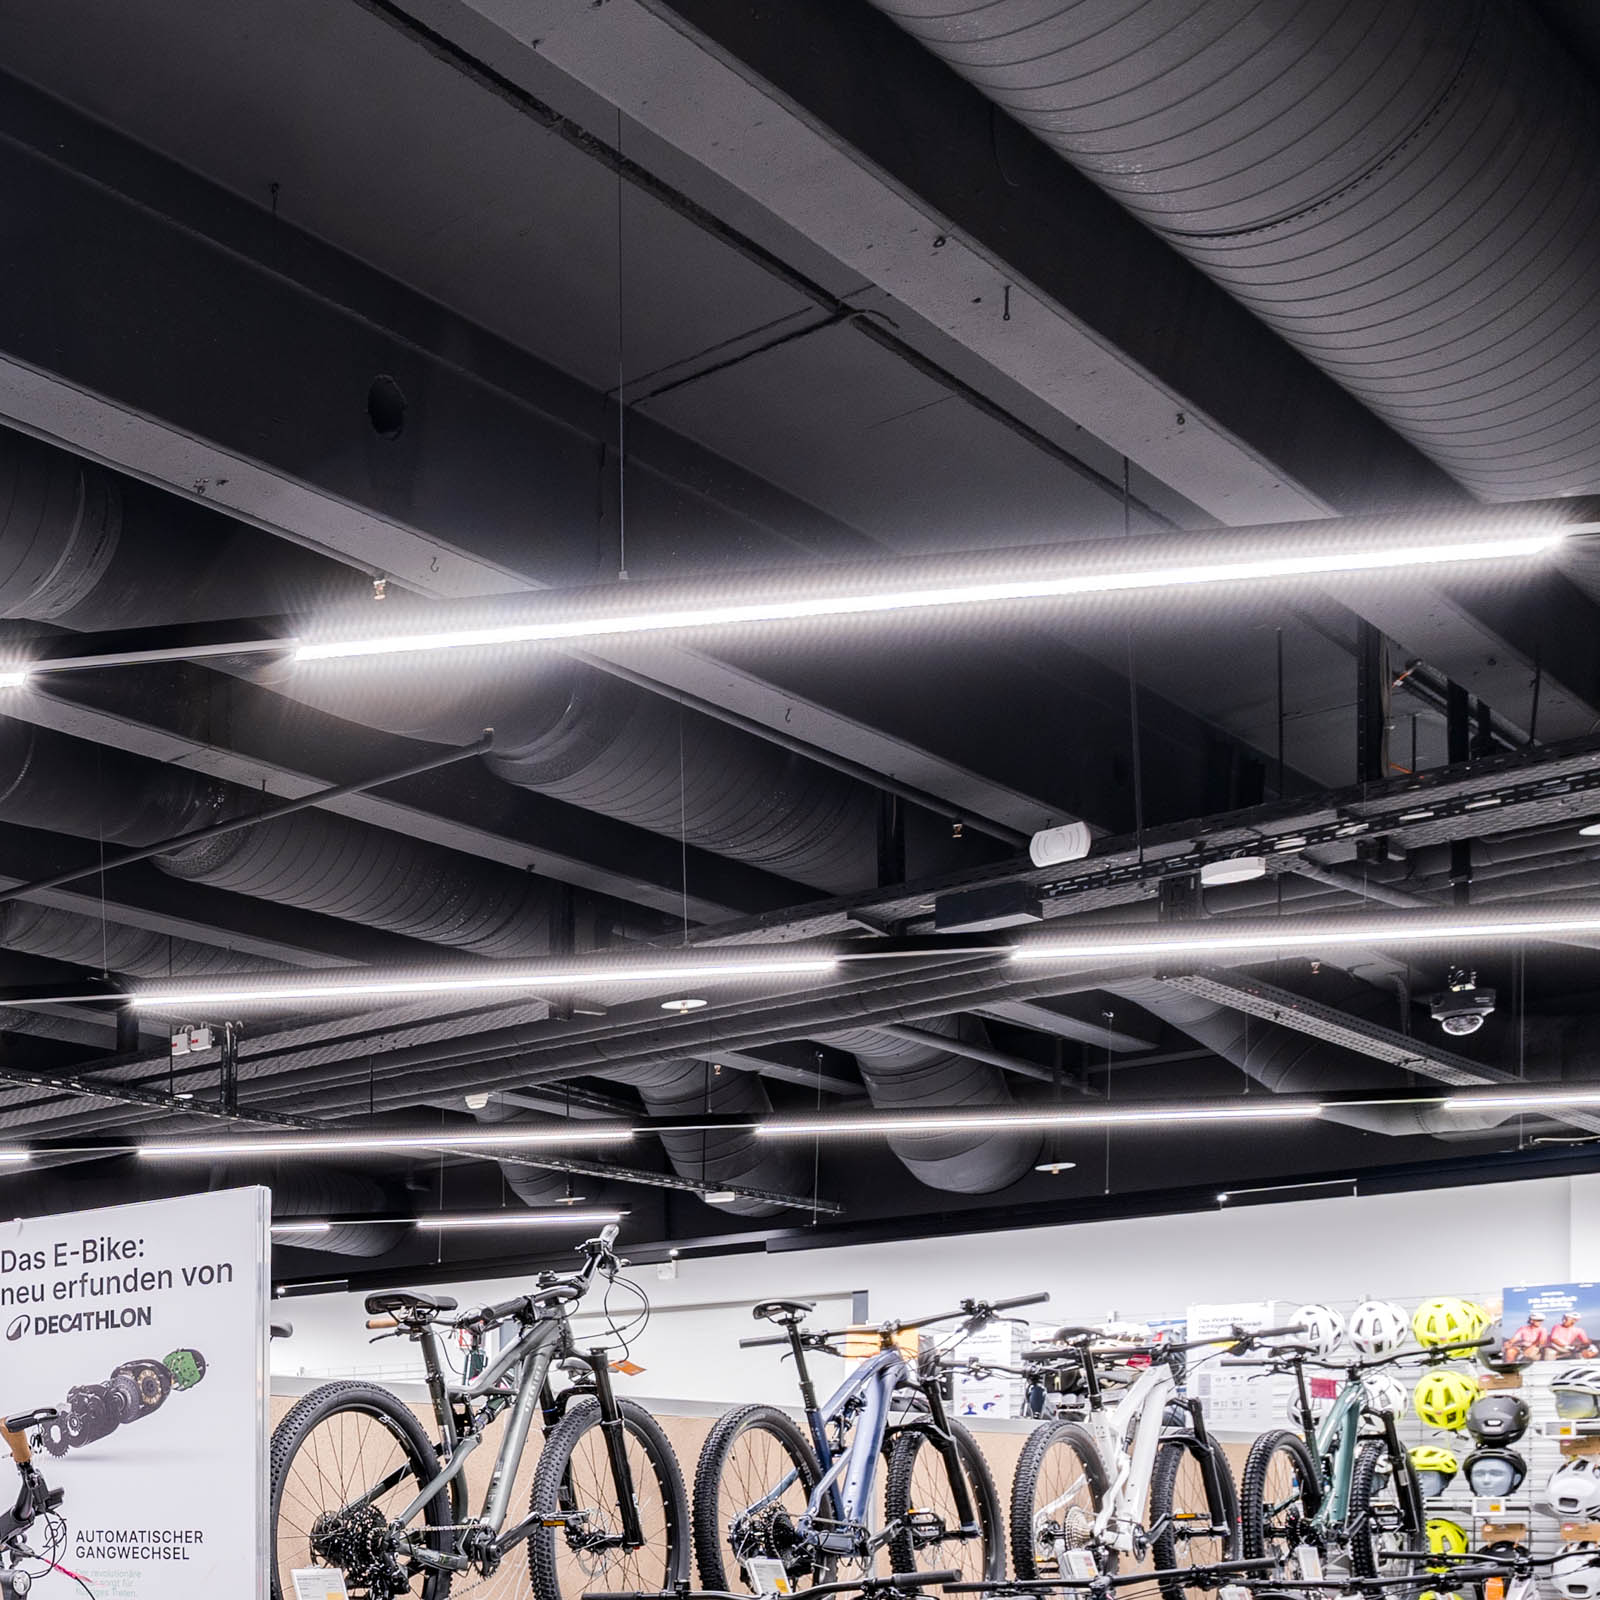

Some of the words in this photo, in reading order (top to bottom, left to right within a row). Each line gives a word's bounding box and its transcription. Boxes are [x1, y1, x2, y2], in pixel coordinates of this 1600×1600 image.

[1, 1249, 46, 1273] Das
[54, 1237, 144, 1267] E-Bike:
[1, 1283, 45, 1306] neu
[53, 1268, 172, 1300] erfunden
[182, 1262, 233, 1287] von
[35, 1306, 152, 1335] DECATHLON
[76, 1530, 203, 1544] AUTOMATISCHER
[76, 1546, 190, 1560] GANGWECHSEL
